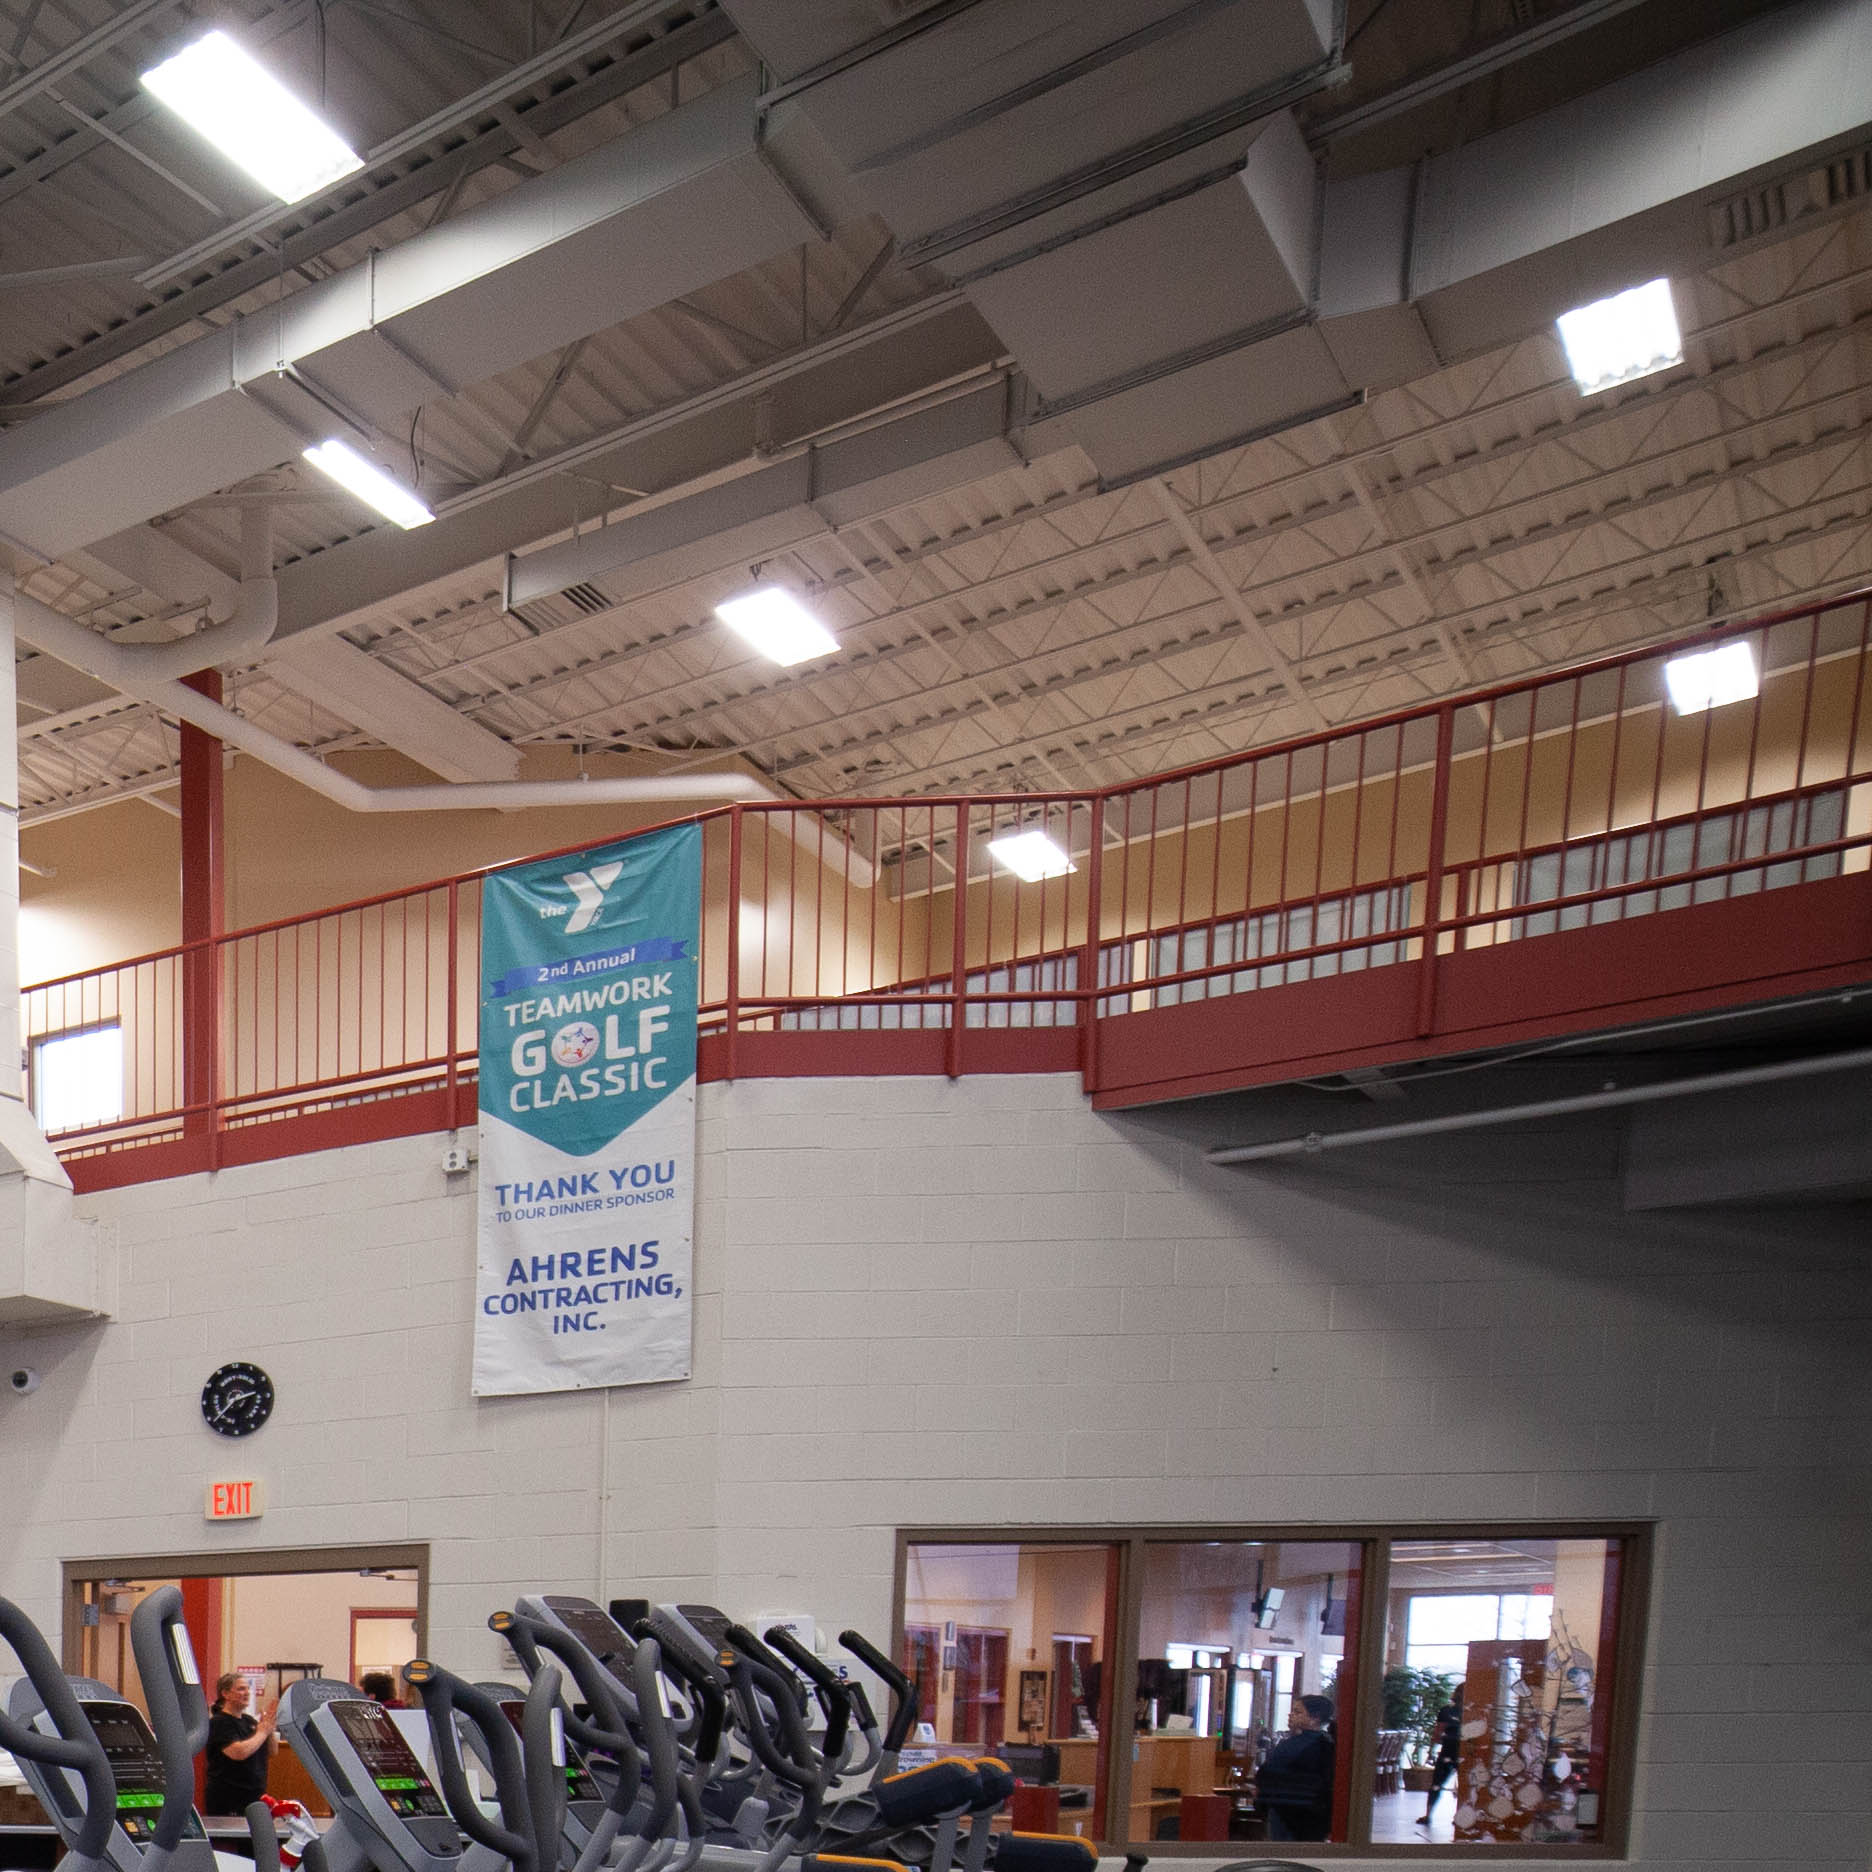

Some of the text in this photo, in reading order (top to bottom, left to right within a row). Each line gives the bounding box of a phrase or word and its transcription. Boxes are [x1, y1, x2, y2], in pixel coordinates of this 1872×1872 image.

[540, 905, 568, 919] the
[537, 948, 636, 983] 2nd Annual
[504, 972, 673, 1027] TEAMWORK
[509, 1055, 667, 1114] CLASSIC
[495, 1159, 676, 1206] THANK YOU
[496, 1188, 675, 1223] TO OUR DINNER SPONSOR
[506, 1240, 660, 1286] AHRENS
[484, 1273, 683, 1315] CONTRACTING,
[553, 1311, 606, 1334] INC.
[213, 1482, 253, 1516] EXIT
